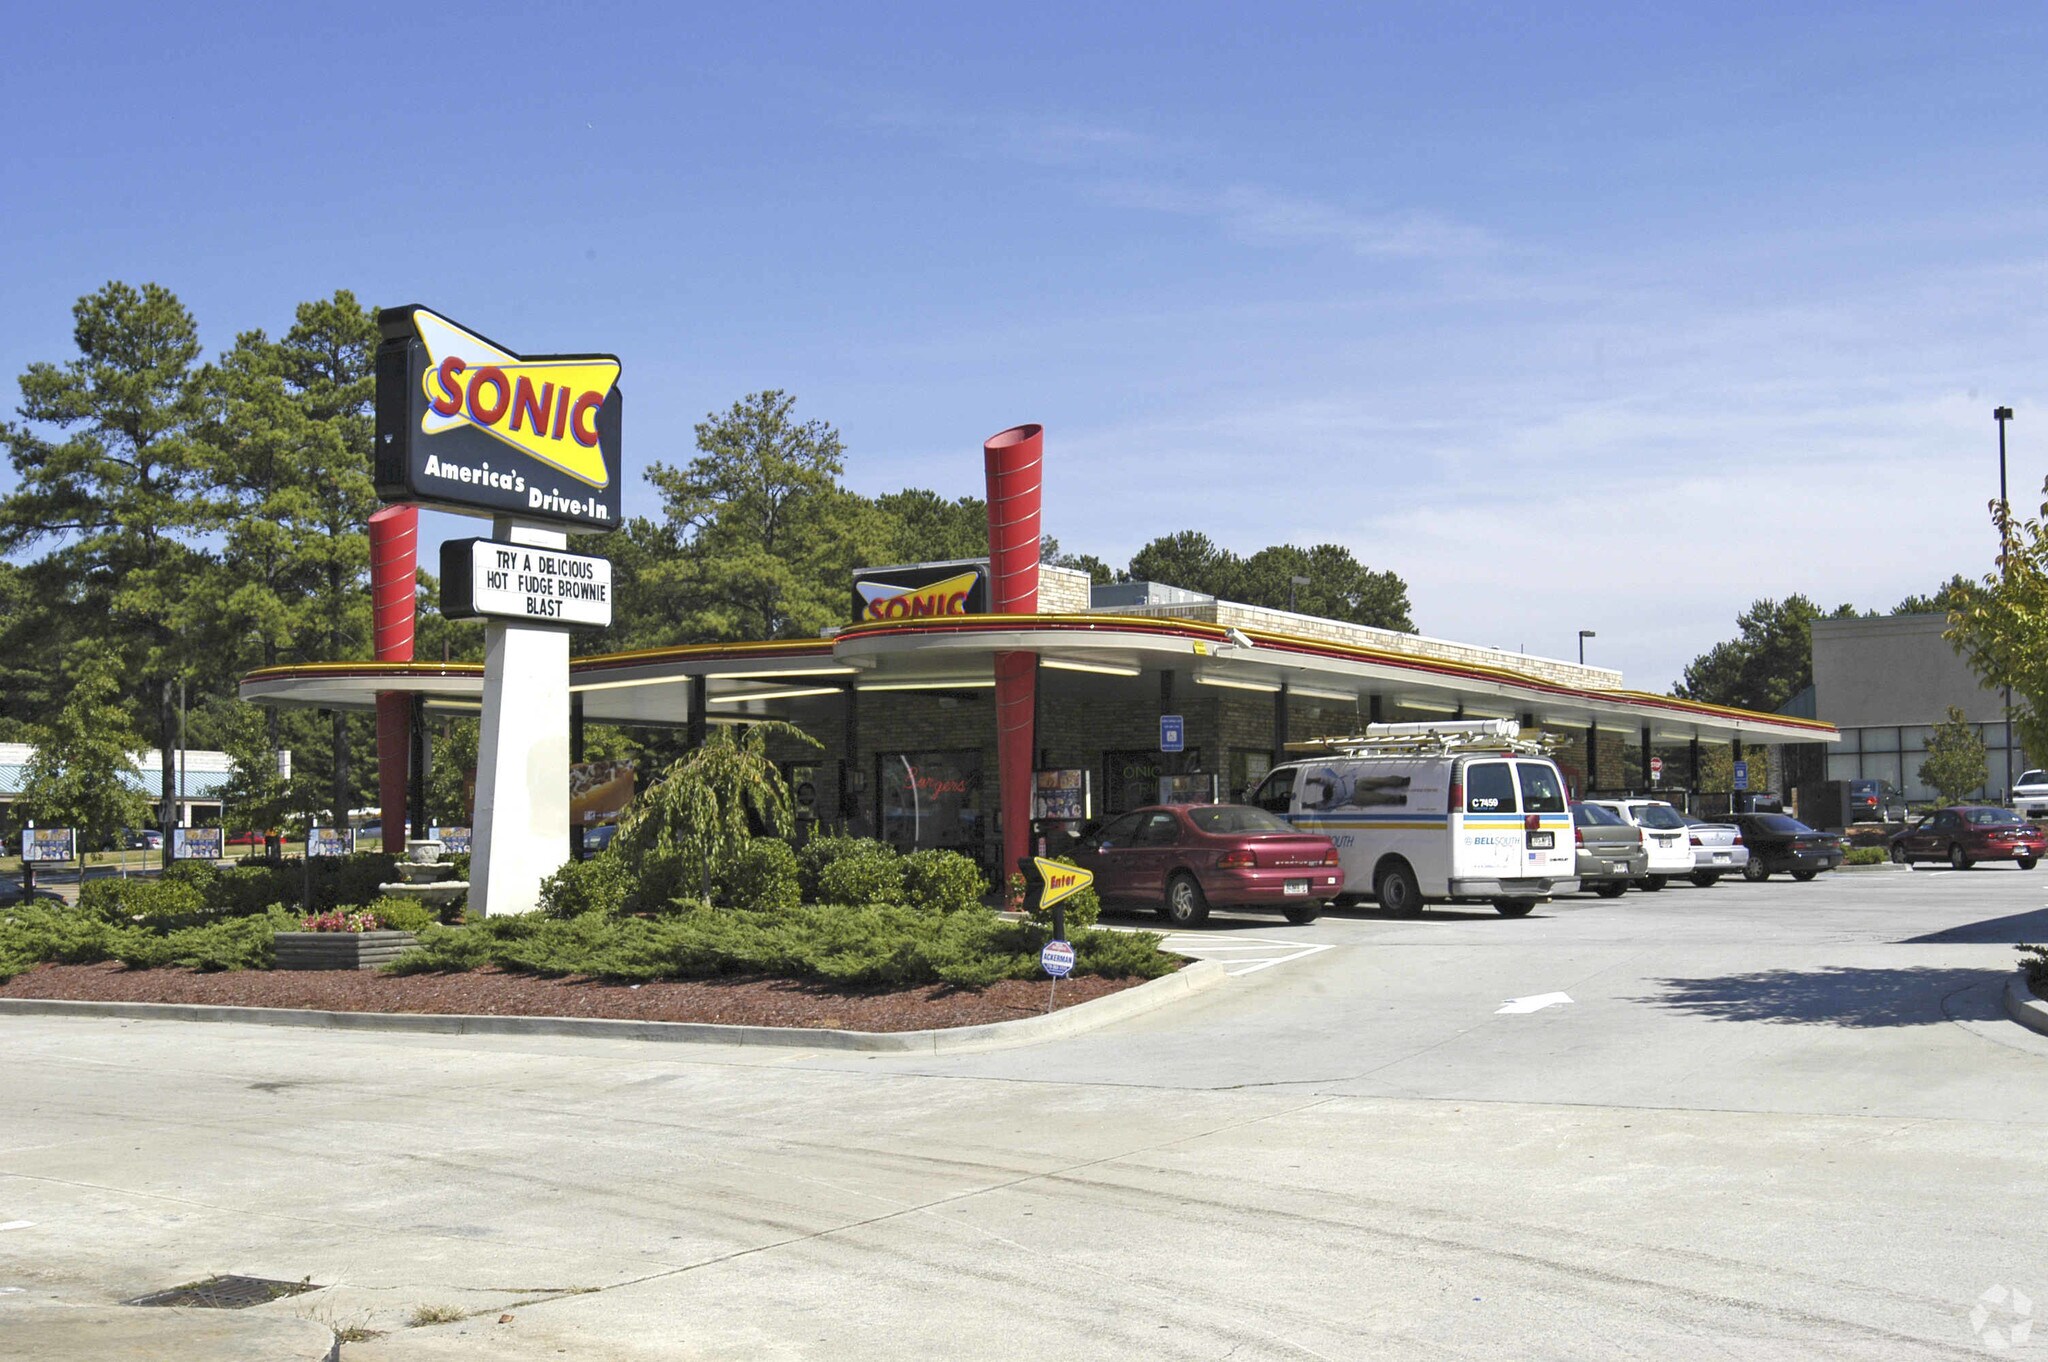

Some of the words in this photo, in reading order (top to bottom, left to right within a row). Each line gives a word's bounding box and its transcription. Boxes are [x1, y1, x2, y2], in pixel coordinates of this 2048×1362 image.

[428, 356, 605, 447] SONIC
[424, 454, 525, 493] America's
[496, 550, 517, 570] TRY
[523, 554, 532, 572] A
[539, 556, 593, 579] DELICIOUS
[487, 570, 508, 590] HOT
[518, 574, 553, 595] FUDGE
[558, 580, 606, 602] BROWNIE
[526, 596, 563, 617] BLAST
[868, 591, 969, 619] SONIC
[1050, 874, 1076, 890] Enter
[1044, 953, 1072, 964] ACKERMAN
